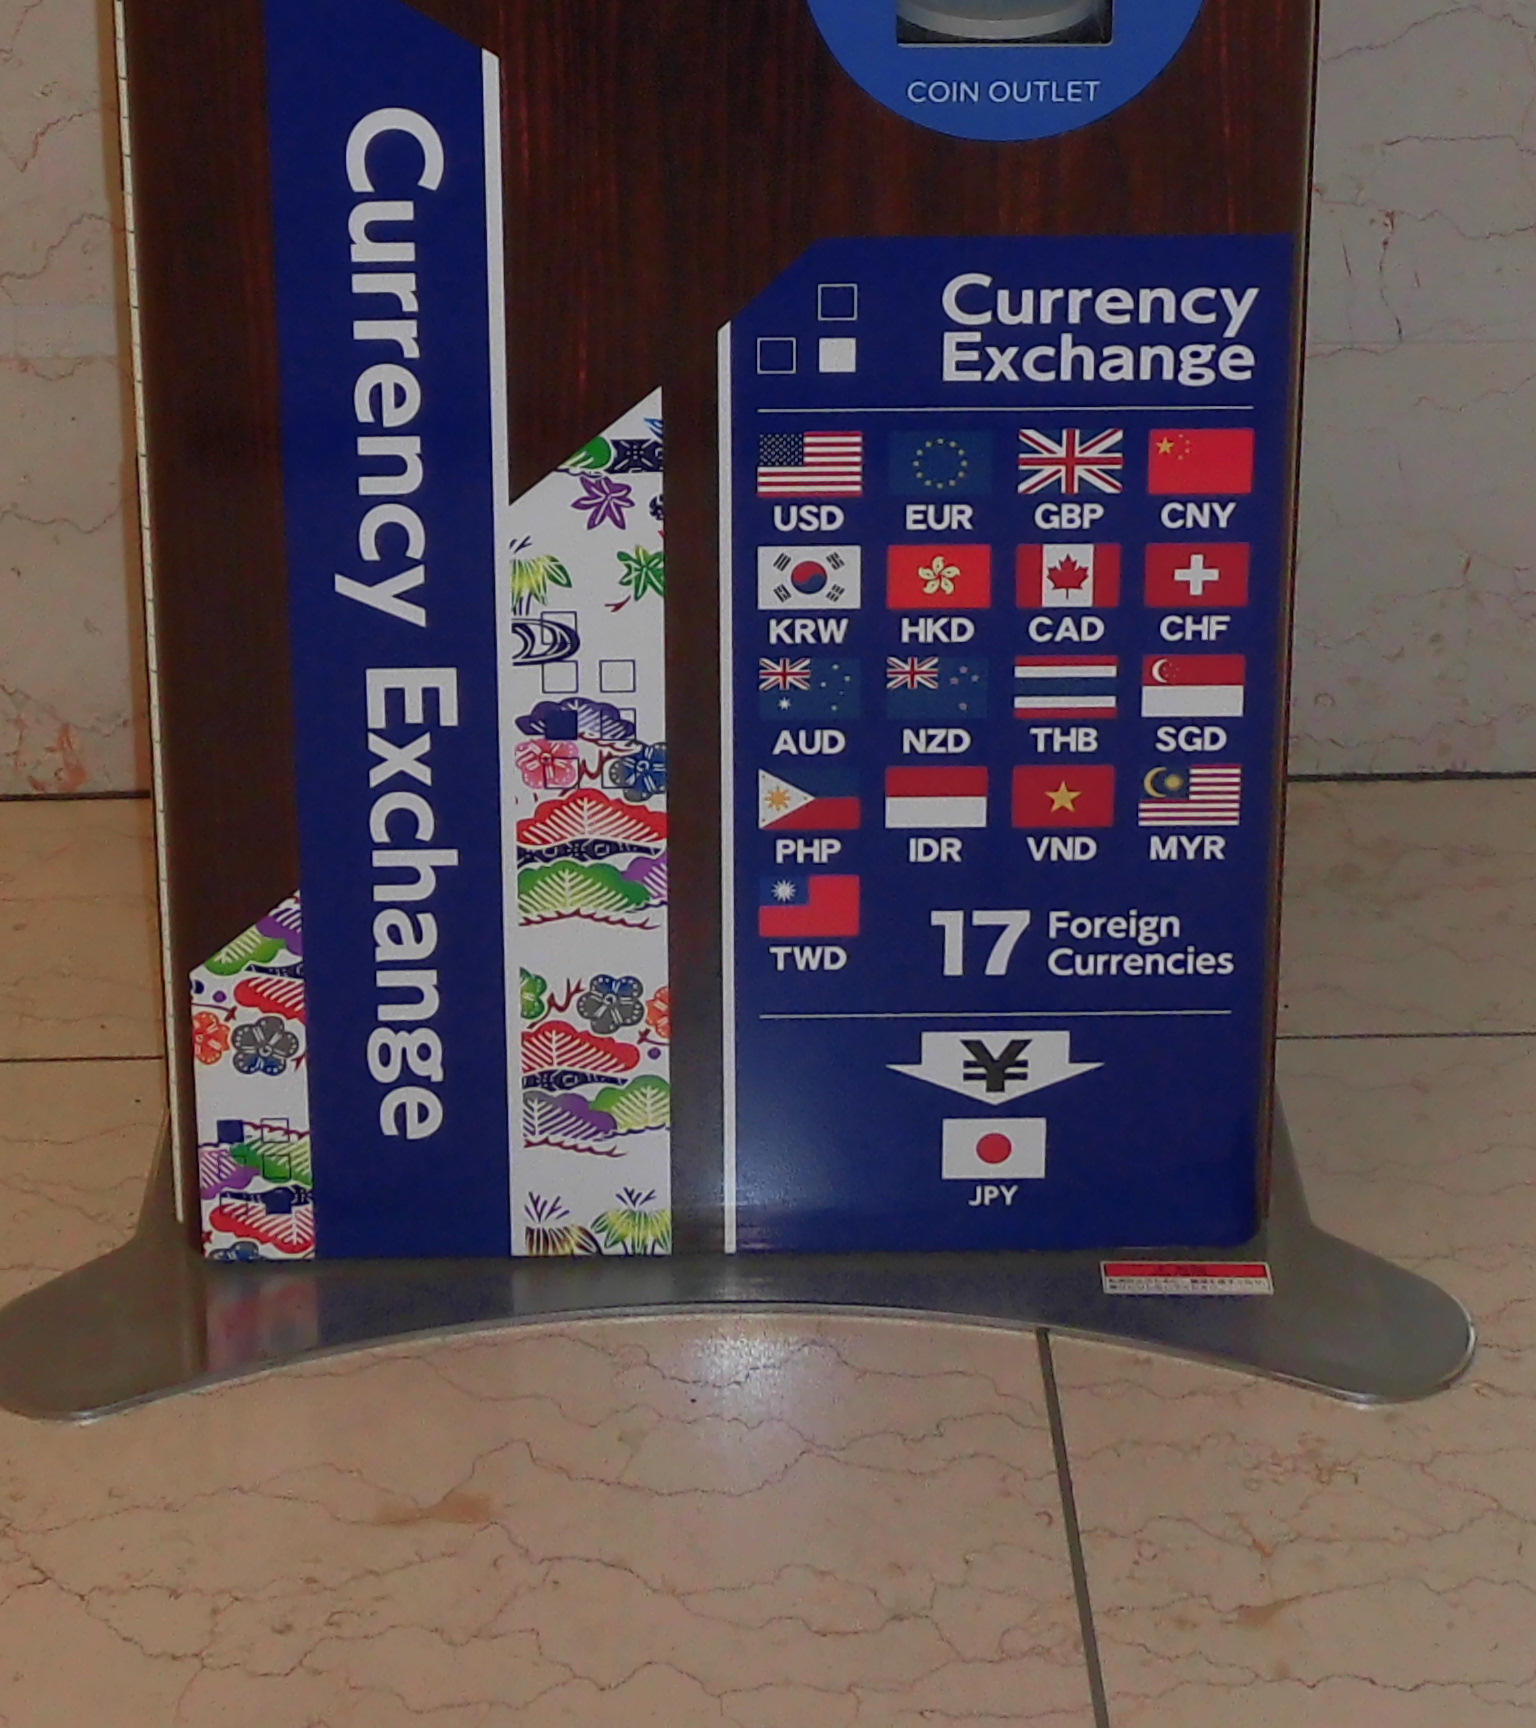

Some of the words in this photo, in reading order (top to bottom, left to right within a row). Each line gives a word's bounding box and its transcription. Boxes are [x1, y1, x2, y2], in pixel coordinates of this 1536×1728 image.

[907, 80, 979, 103] COIN
[988, 80, 1101, 103] OUTLET
[942, 272, 1260, 338] Currency
[334, 106, 445, 630] Currency
[942, 332, 1256, 387] Exchange
[773, 505, 845, 532] USD
[905, 504, 974, 530] EUR
[1034, 503, 1104, 529] GBP
[1160, 502, 1237, 528] CNY
[769, 618, 848, 645] KRW
[901, 617, 975, 643] HKD
[1028, 616, 1105, 642] CAD
[1159, 615, 1231, 641] CHF
[772, 729, 846, 755] AUD
[902, 728, 972, 754] NZD
[1030, 727, 1099, 753] THB
[1155, 726, 1227, 752] SGD
[775, 838, 842, 864] PHP
[909, 838, 962, 863] IDR
[1027, 836, 1097, 862] VND
[1149, 836, 1225, 861] MYR
[364, 666, 459, 1142] Exchange
[930, 909, 1031, 976] 17
[1048, 909, 1181, 946] Foreign
[769, 946, 848, 972] TWD
[1048, 947, 1235, 976] Currencies
[968, 1185, 1019, 1207] JPY
